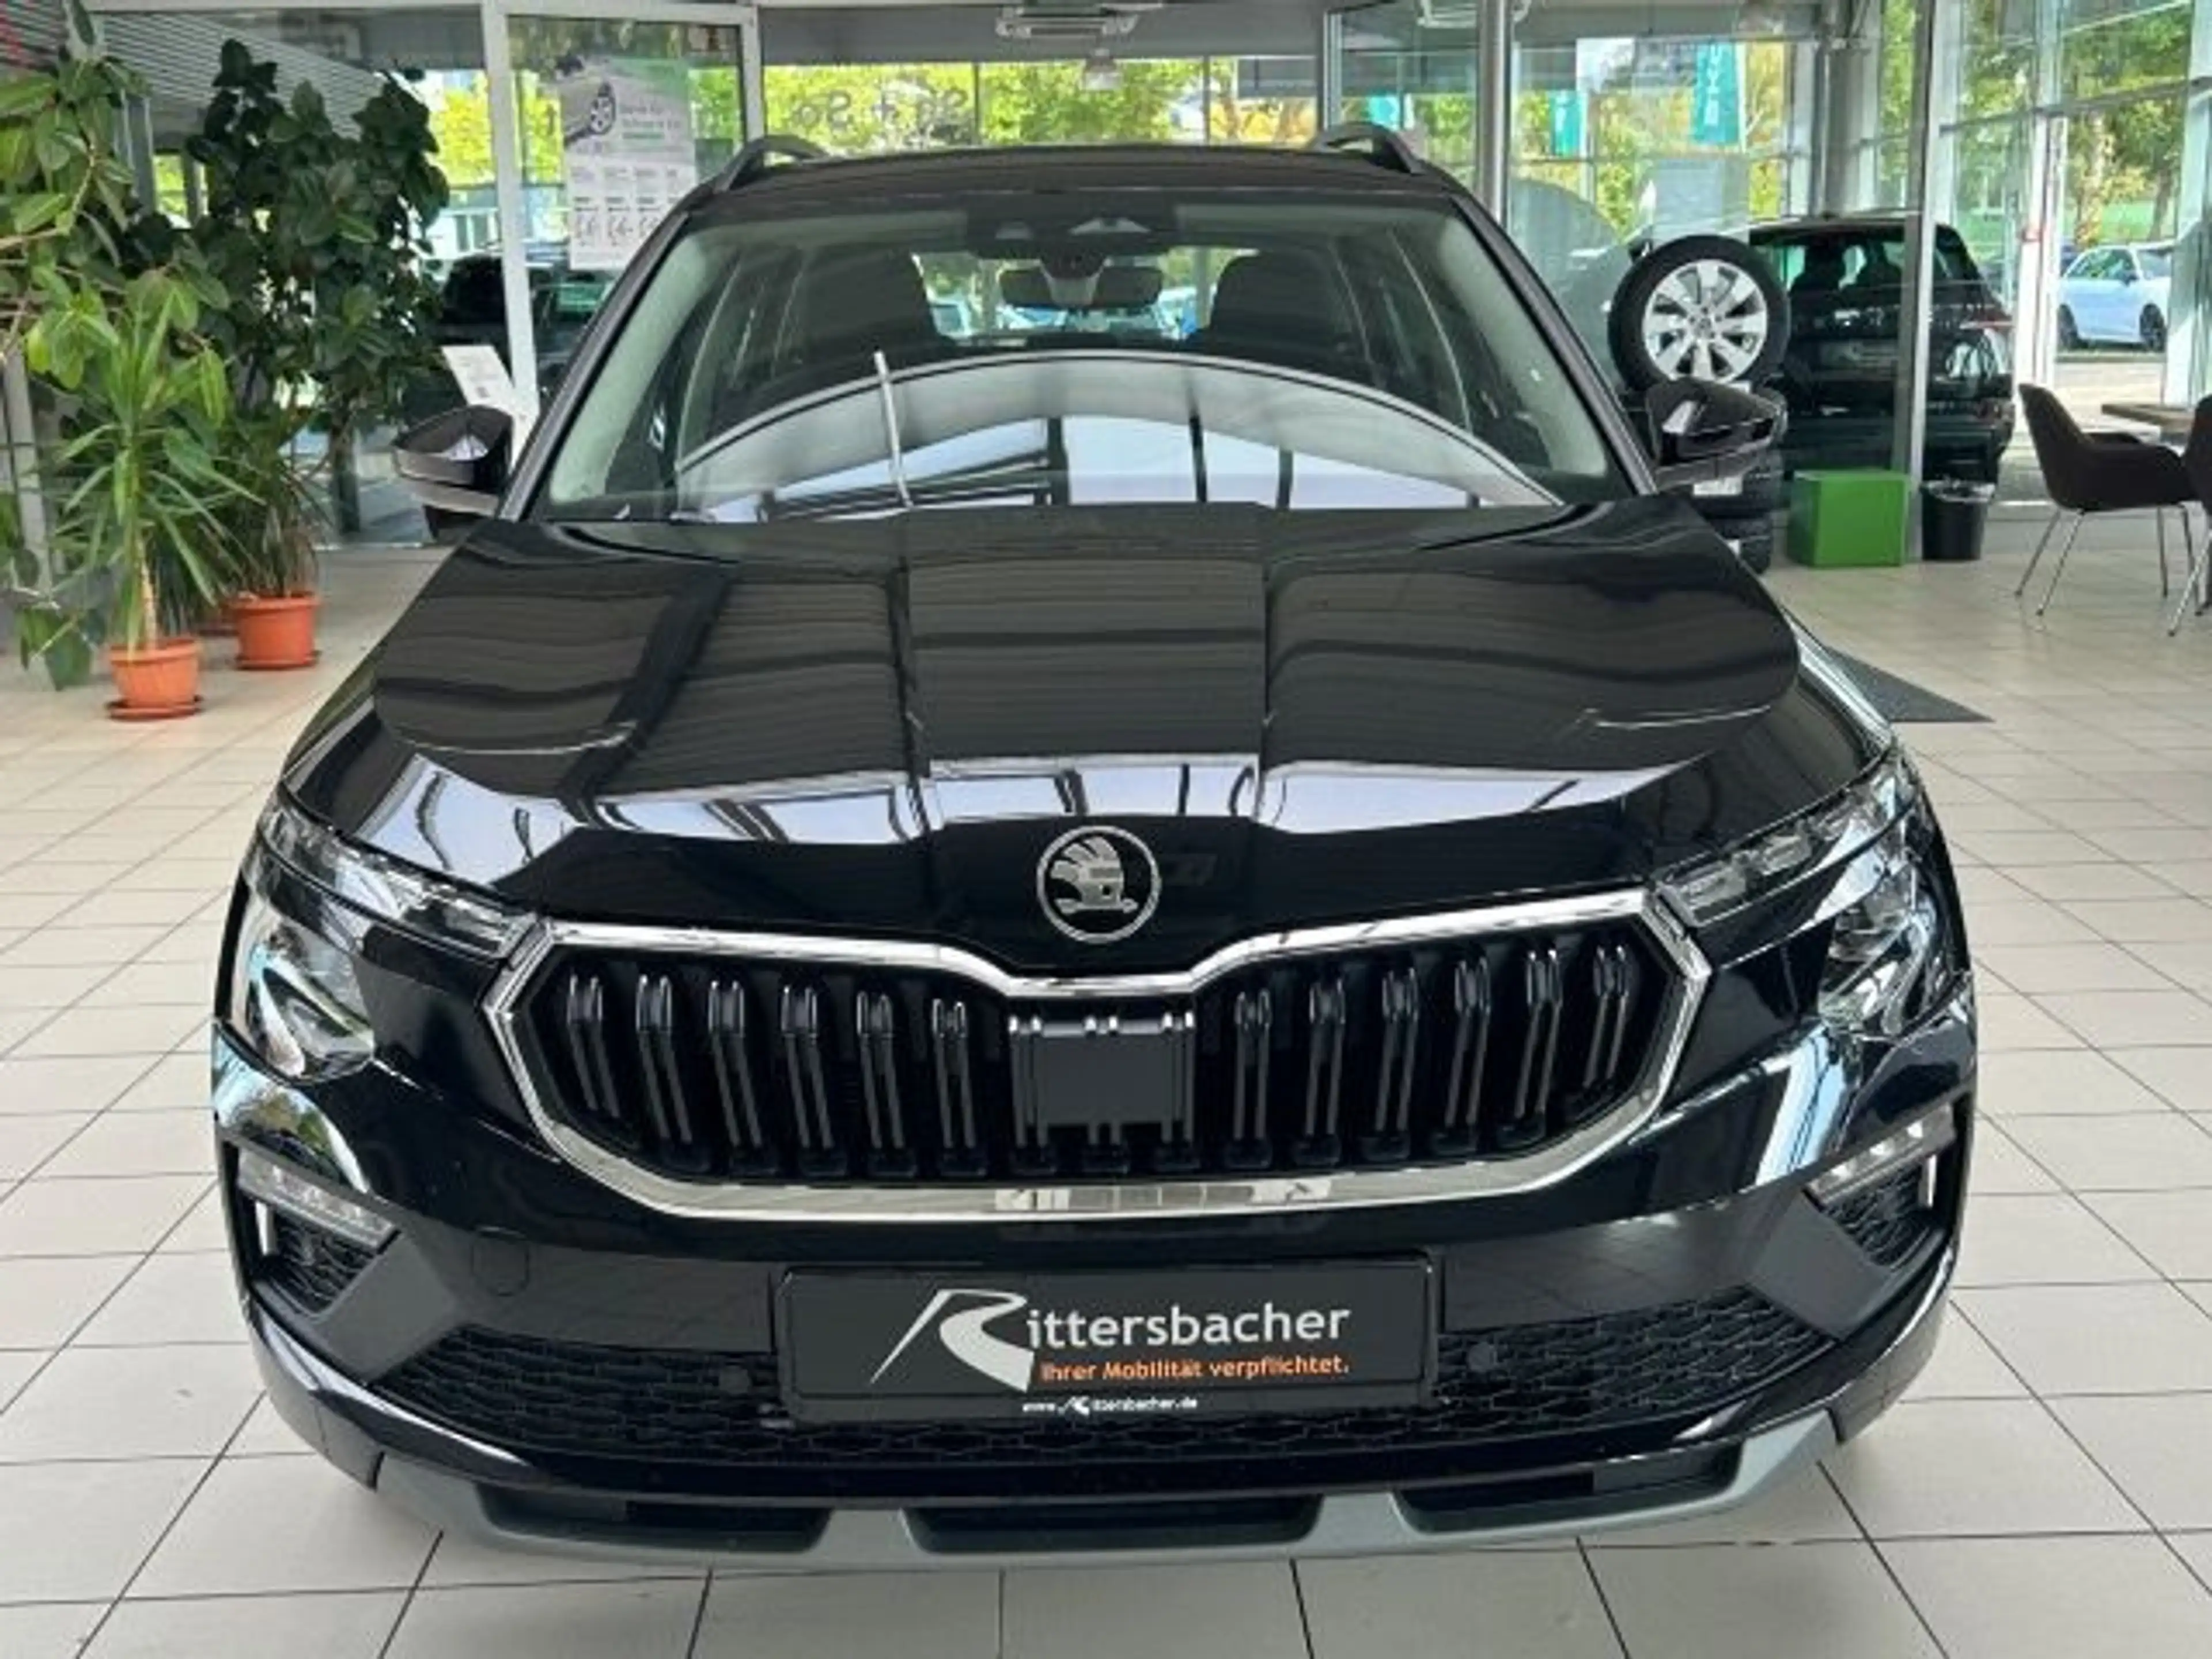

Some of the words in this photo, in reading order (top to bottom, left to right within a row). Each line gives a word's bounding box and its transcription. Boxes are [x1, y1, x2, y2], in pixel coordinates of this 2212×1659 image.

[869, 1289, 1351, 1393] Rittersbacher
[1041, 1363, 1097, 1381] Ihrer
[1103, 1358, 1203, 1380] Mobilität
[1209, 1354, 1350, 1380] verpflichtet.
